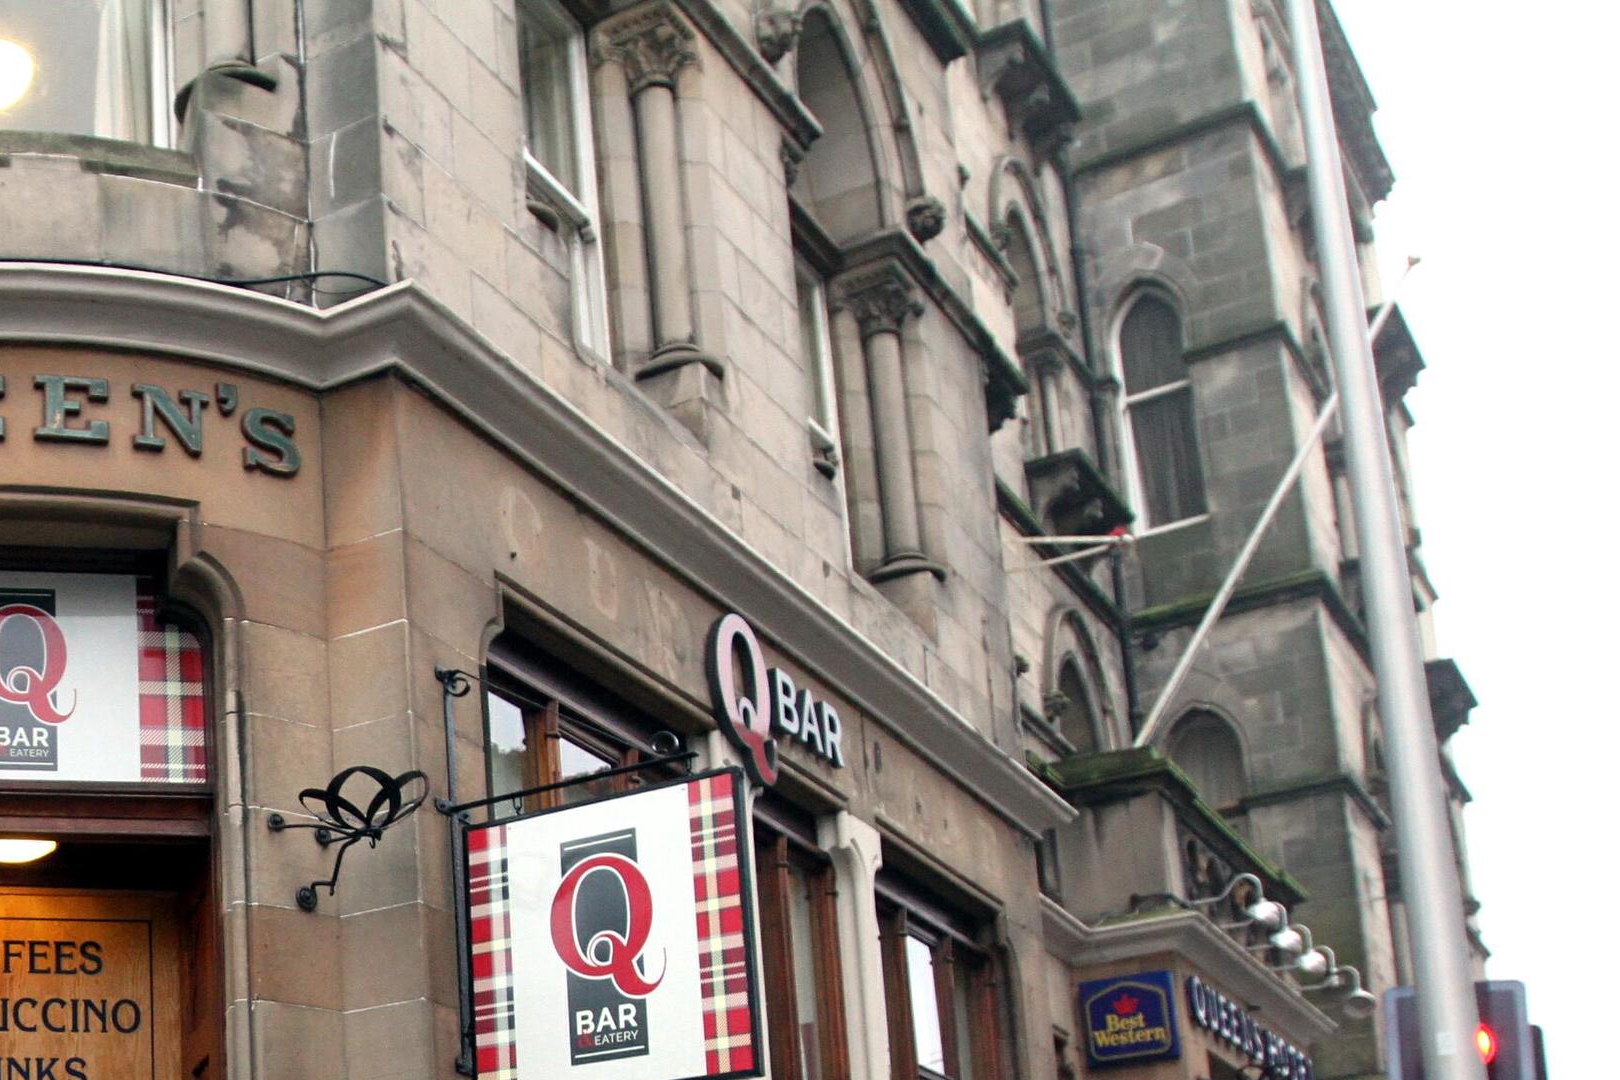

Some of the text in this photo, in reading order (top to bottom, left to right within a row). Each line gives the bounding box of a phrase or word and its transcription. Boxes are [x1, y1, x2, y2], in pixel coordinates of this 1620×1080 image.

[707, 613, 845, 786] Q BAR
[9, 748, 49, 758] EATERY
[550, 852, 667, 999] Q
[576, 1003, 638, 1036] BAR
[1105, 1012, 1145, 1031] Best
[594, 1030, 639, 1046] EATERY
[1093, 1026, 1166, 1048] Western
